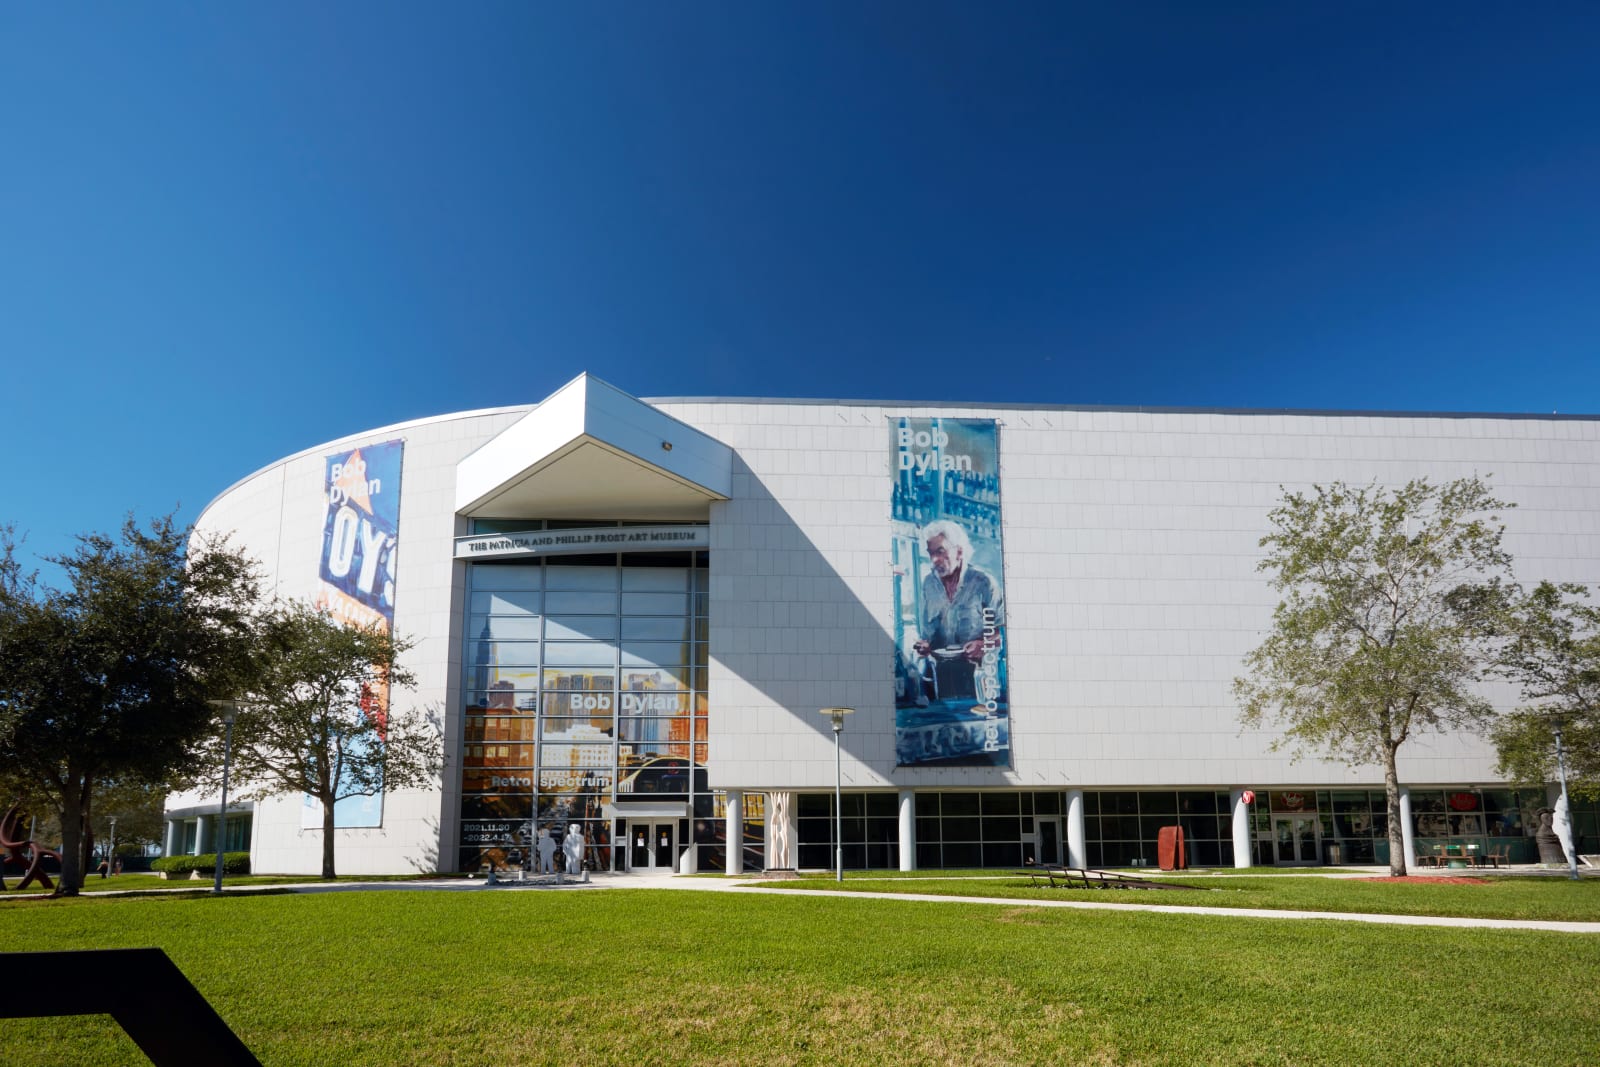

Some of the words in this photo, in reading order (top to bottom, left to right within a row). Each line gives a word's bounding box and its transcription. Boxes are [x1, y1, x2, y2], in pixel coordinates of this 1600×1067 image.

[897, 428, 949, 449] Bob
[331, 458, 367, 483] Bob
[898, 450, 972, 476] Dylan
[330, 478, 381, 507] Dylan
[468, 542, 488, 552] THE
[489, 538, 530, 551] PATRICIA
[531, 536, 553, 546] AND
[555, 534, 593, 545] PHILLIP
[594, 533, 626, 543] FROST
[628, 533, 648, 542] ART
[650, 531, 697, 542] MUSEUM
[981, 607, 1000, 752] Retrospectrum
[570, 693, 611, 711] Bob
[621, 693, 680, 713] Dylan
